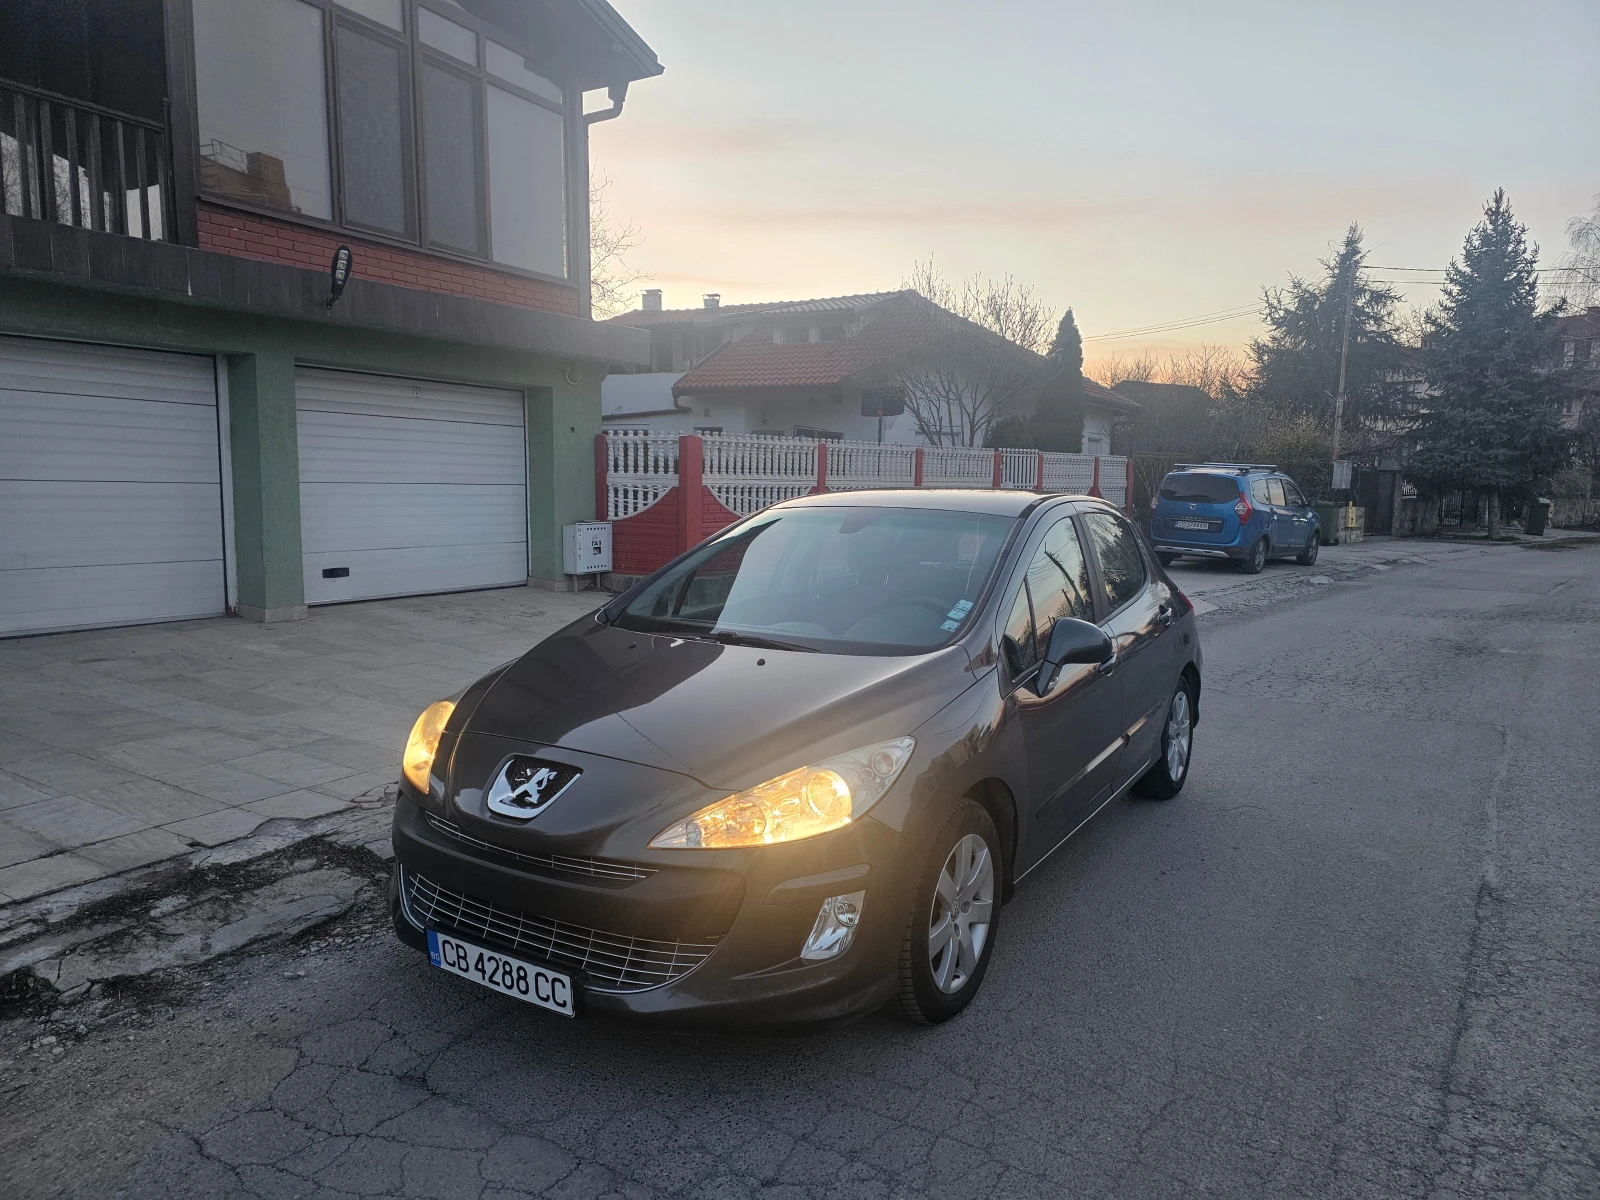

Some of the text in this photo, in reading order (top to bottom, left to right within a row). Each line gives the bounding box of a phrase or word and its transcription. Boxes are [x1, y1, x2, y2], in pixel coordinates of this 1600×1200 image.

[430, 951, 440, 961] BG
[442, 939, 567, 1008] CB 4288 CC
